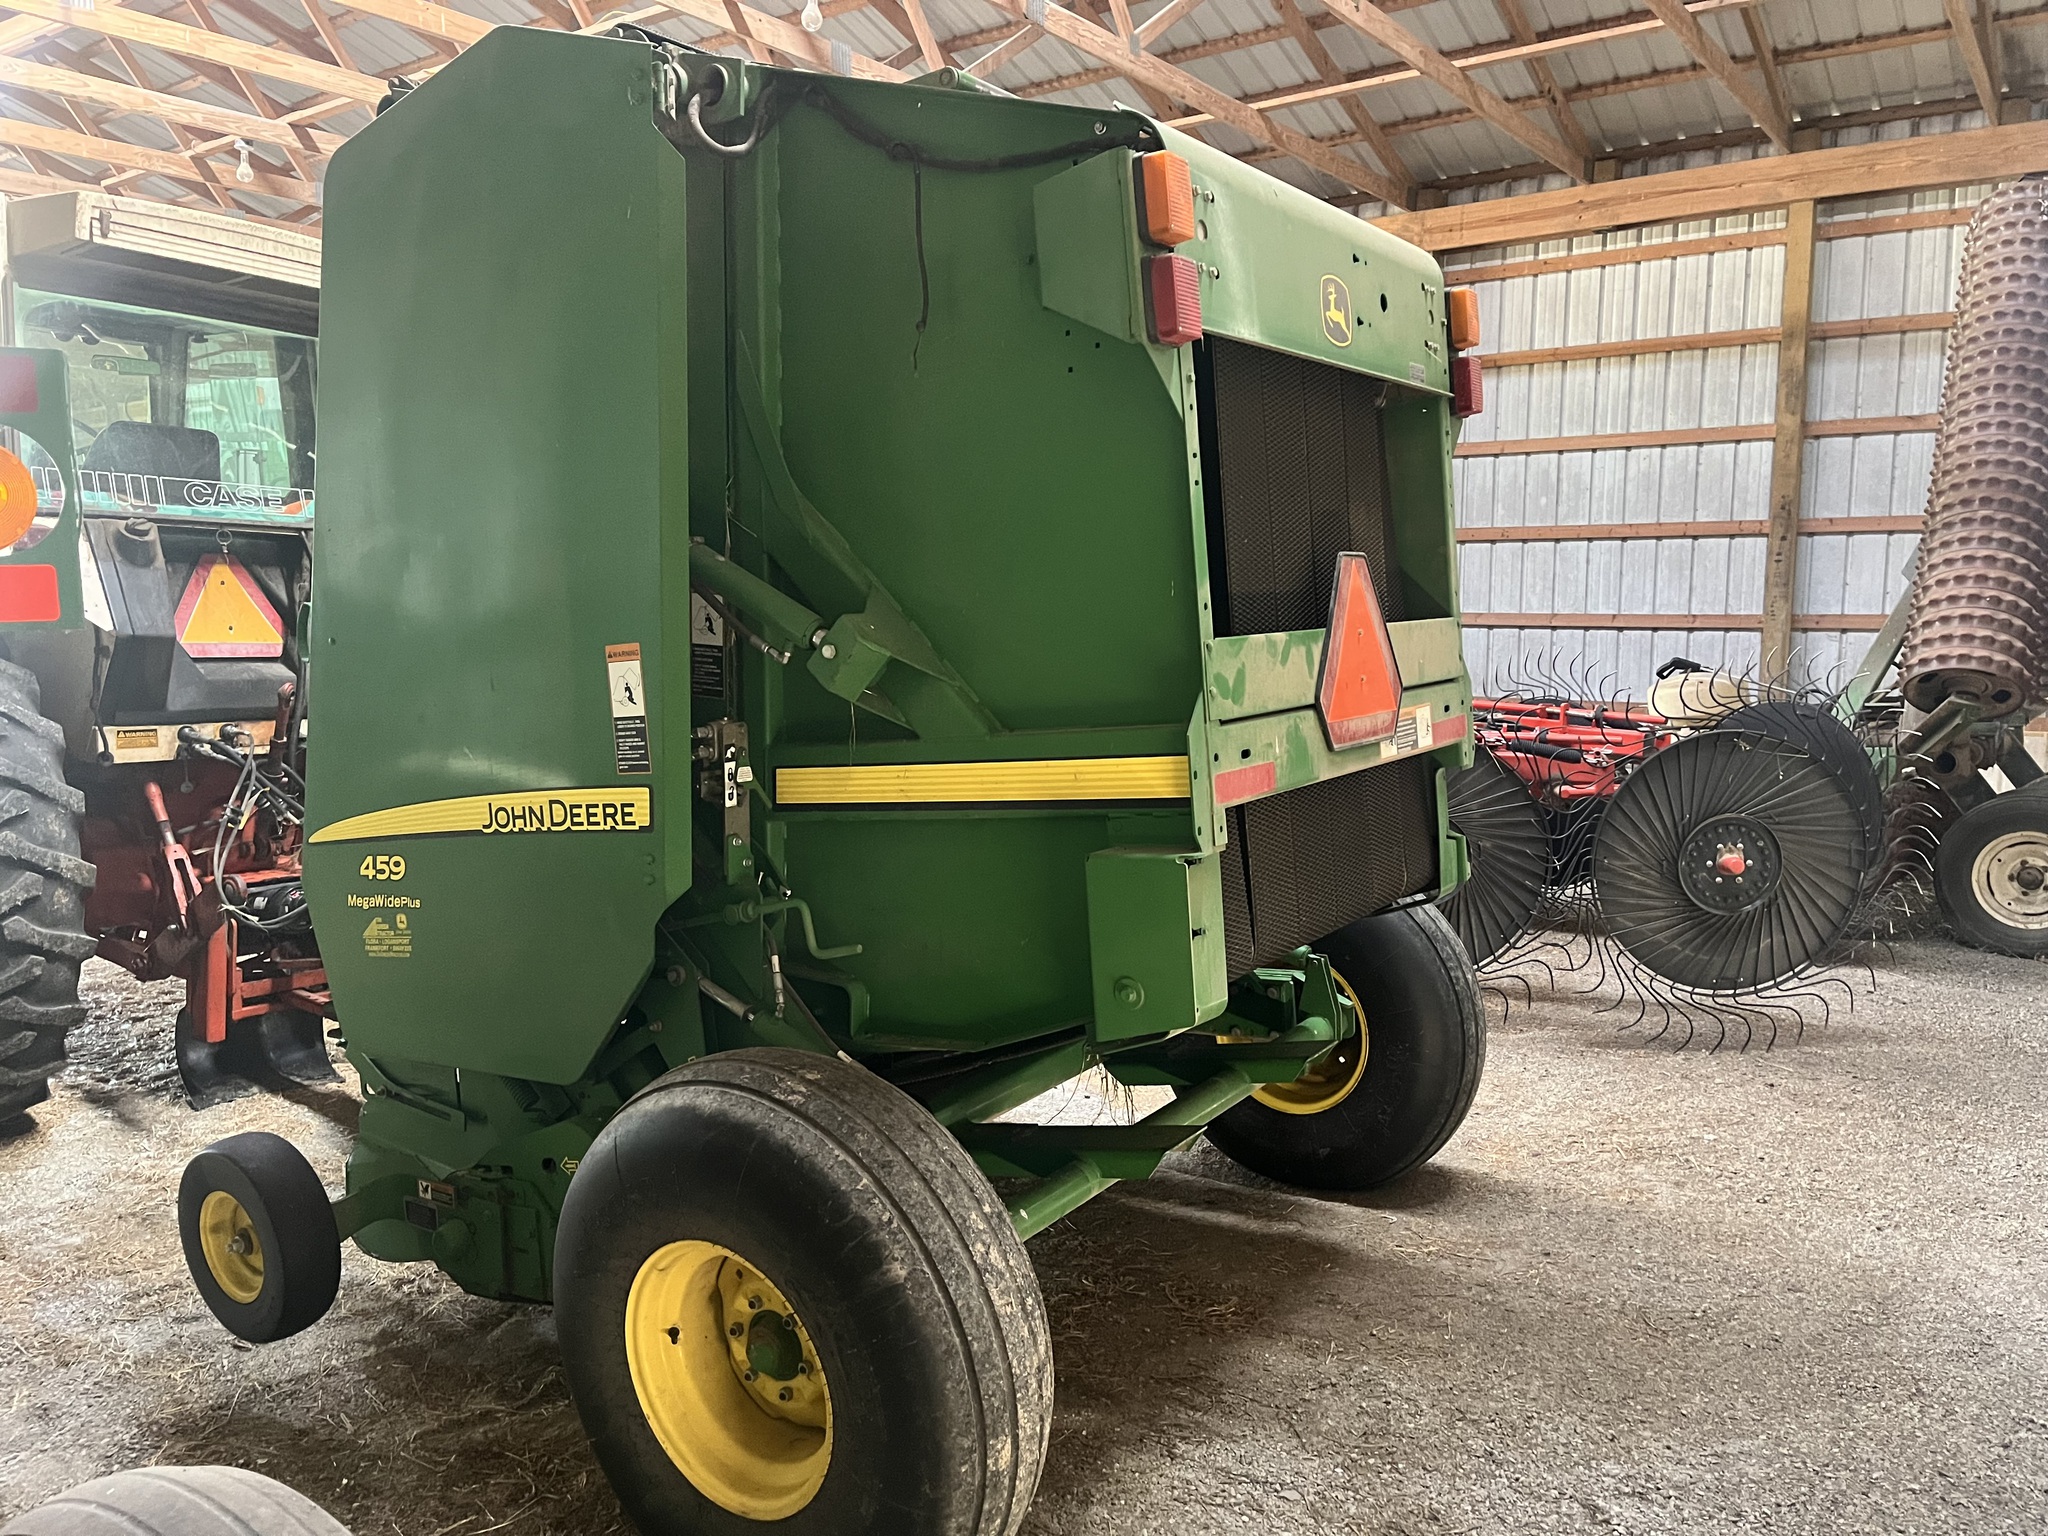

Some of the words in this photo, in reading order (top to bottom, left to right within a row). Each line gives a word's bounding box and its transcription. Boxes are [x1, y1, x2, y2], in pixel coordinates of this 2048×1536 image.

[184, 481, 285, 513] CASE
[612, 649, 639, 658] WARNING
[125, 730, 157, 738] WARNING
[481, 802, 546, 832] JOHN
[547, 799, 637, 829] DEERE
[360, 855, 406, 881] 459
[347, 894, 421, 909] MegaWidePlus
